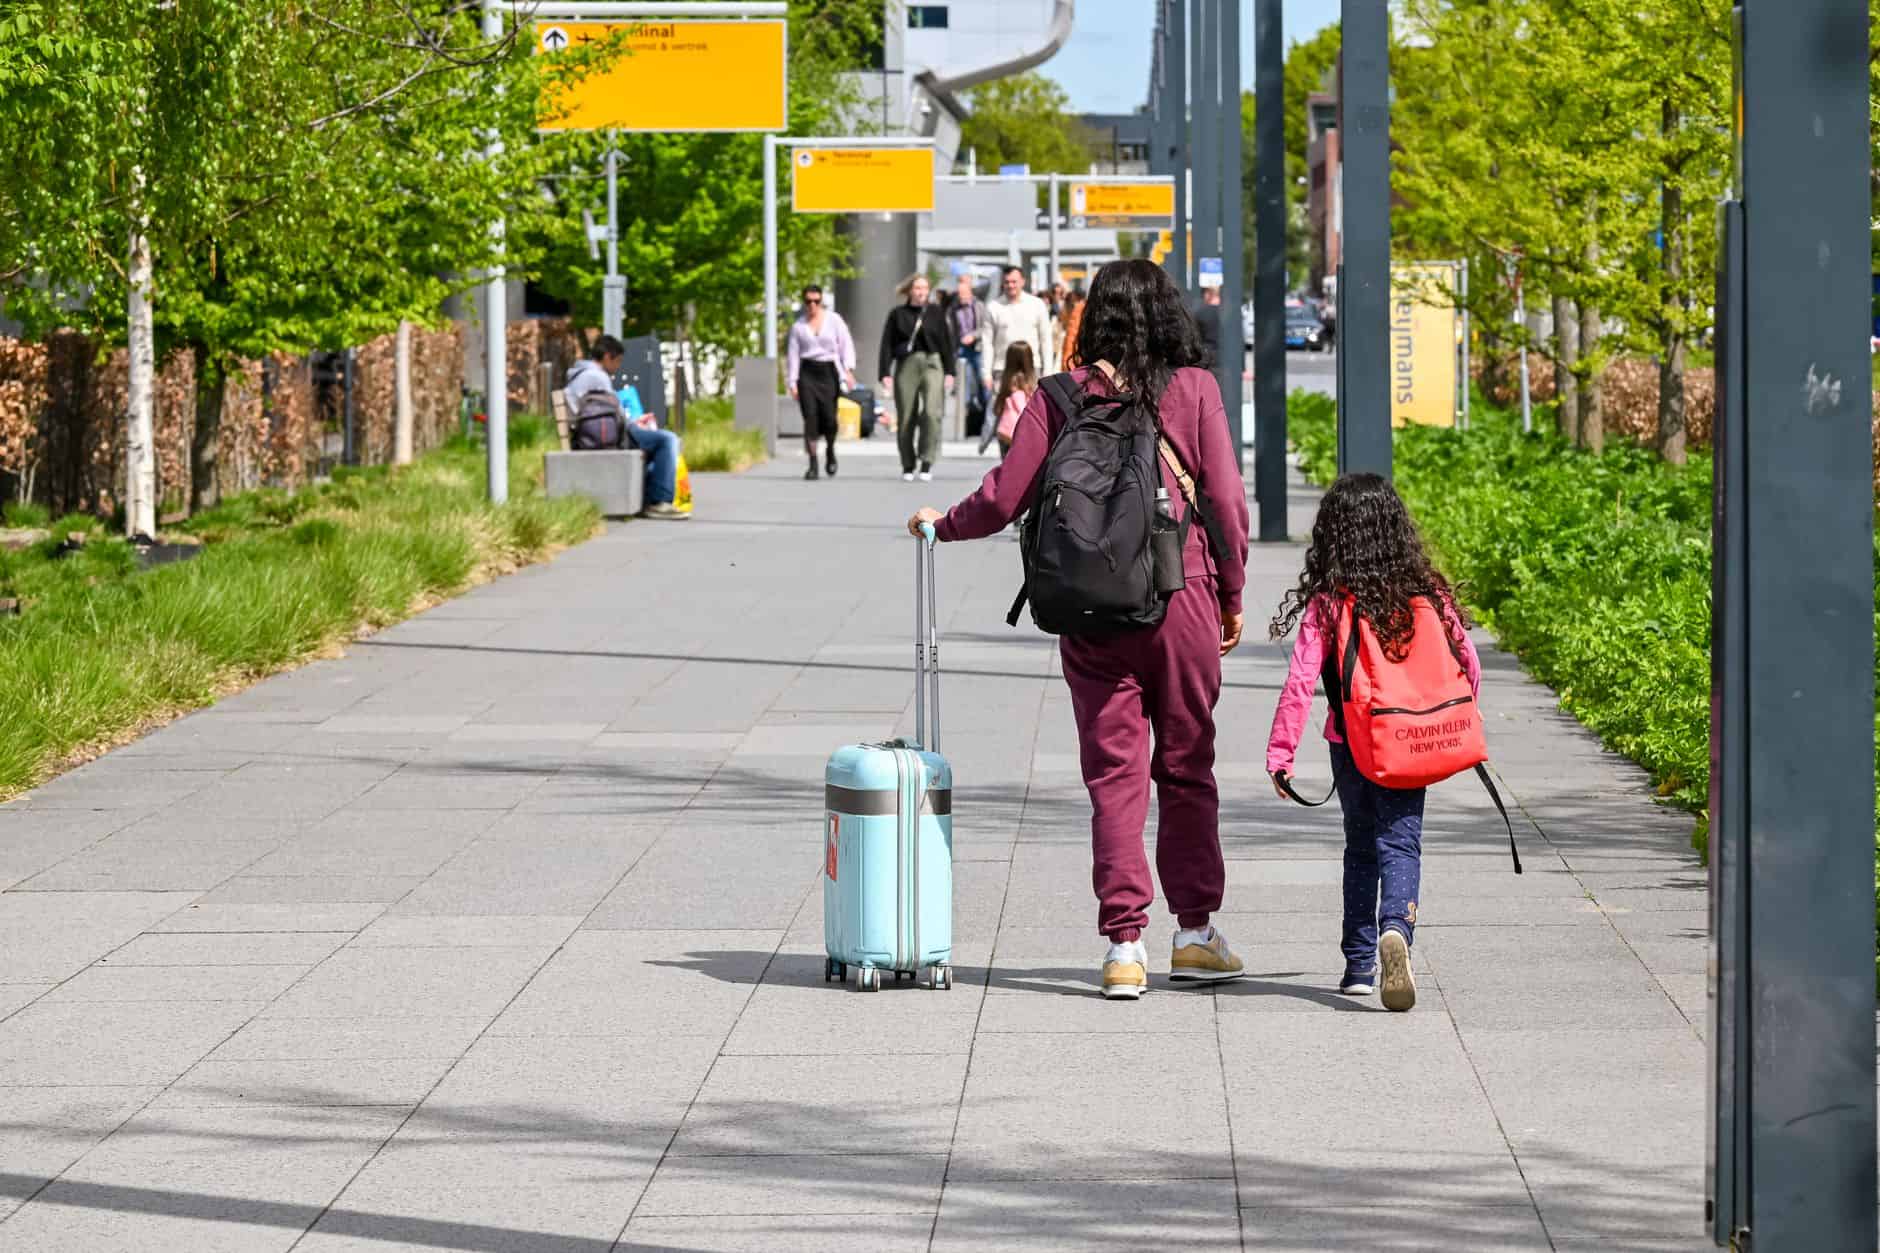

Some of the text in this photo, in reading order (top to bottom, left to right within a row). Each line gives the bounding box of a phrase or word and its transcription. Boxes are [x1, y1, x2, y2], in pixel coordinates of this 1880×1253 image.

[603, 23, 675, 38] Teminal
[1395, 718, 1471, 741] CALVIN KLEIN
[1410, 737, 1462, 754] NEW YORK
